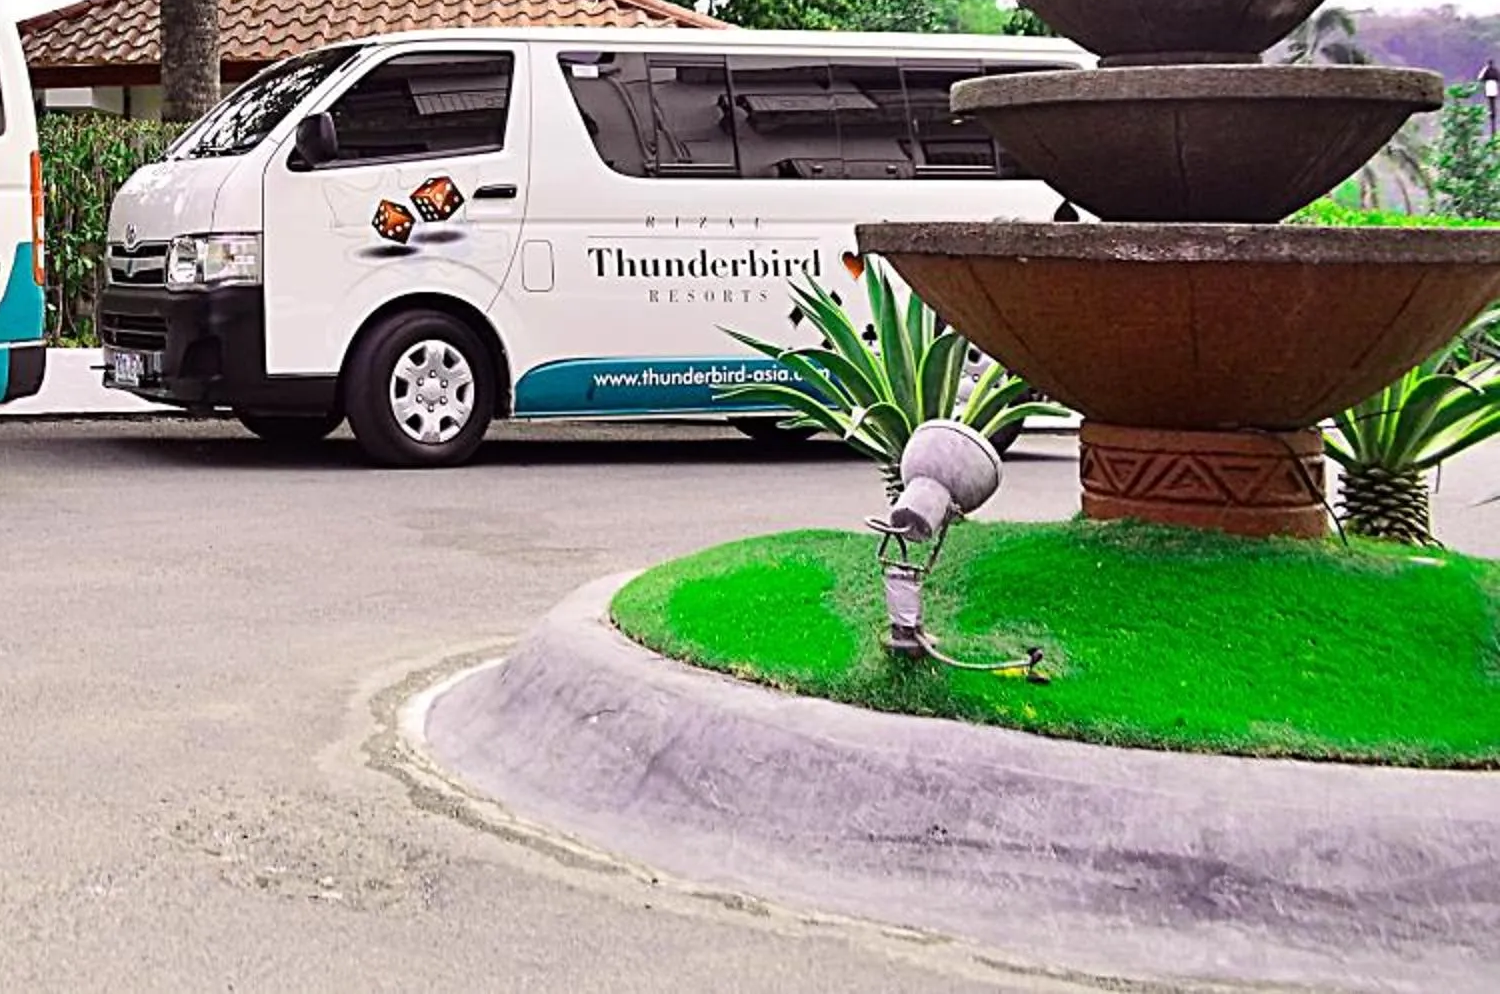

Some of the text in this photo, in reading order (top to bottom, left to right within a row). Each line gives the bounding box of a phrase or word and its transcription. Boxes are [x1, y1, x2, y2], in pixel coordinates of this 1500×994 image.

[587, 247, 821, 279] Thunderbird
[649, 289, 769, 304] RESORTS
[593, 363, 831, 386] www.thunderbird-asia.c
